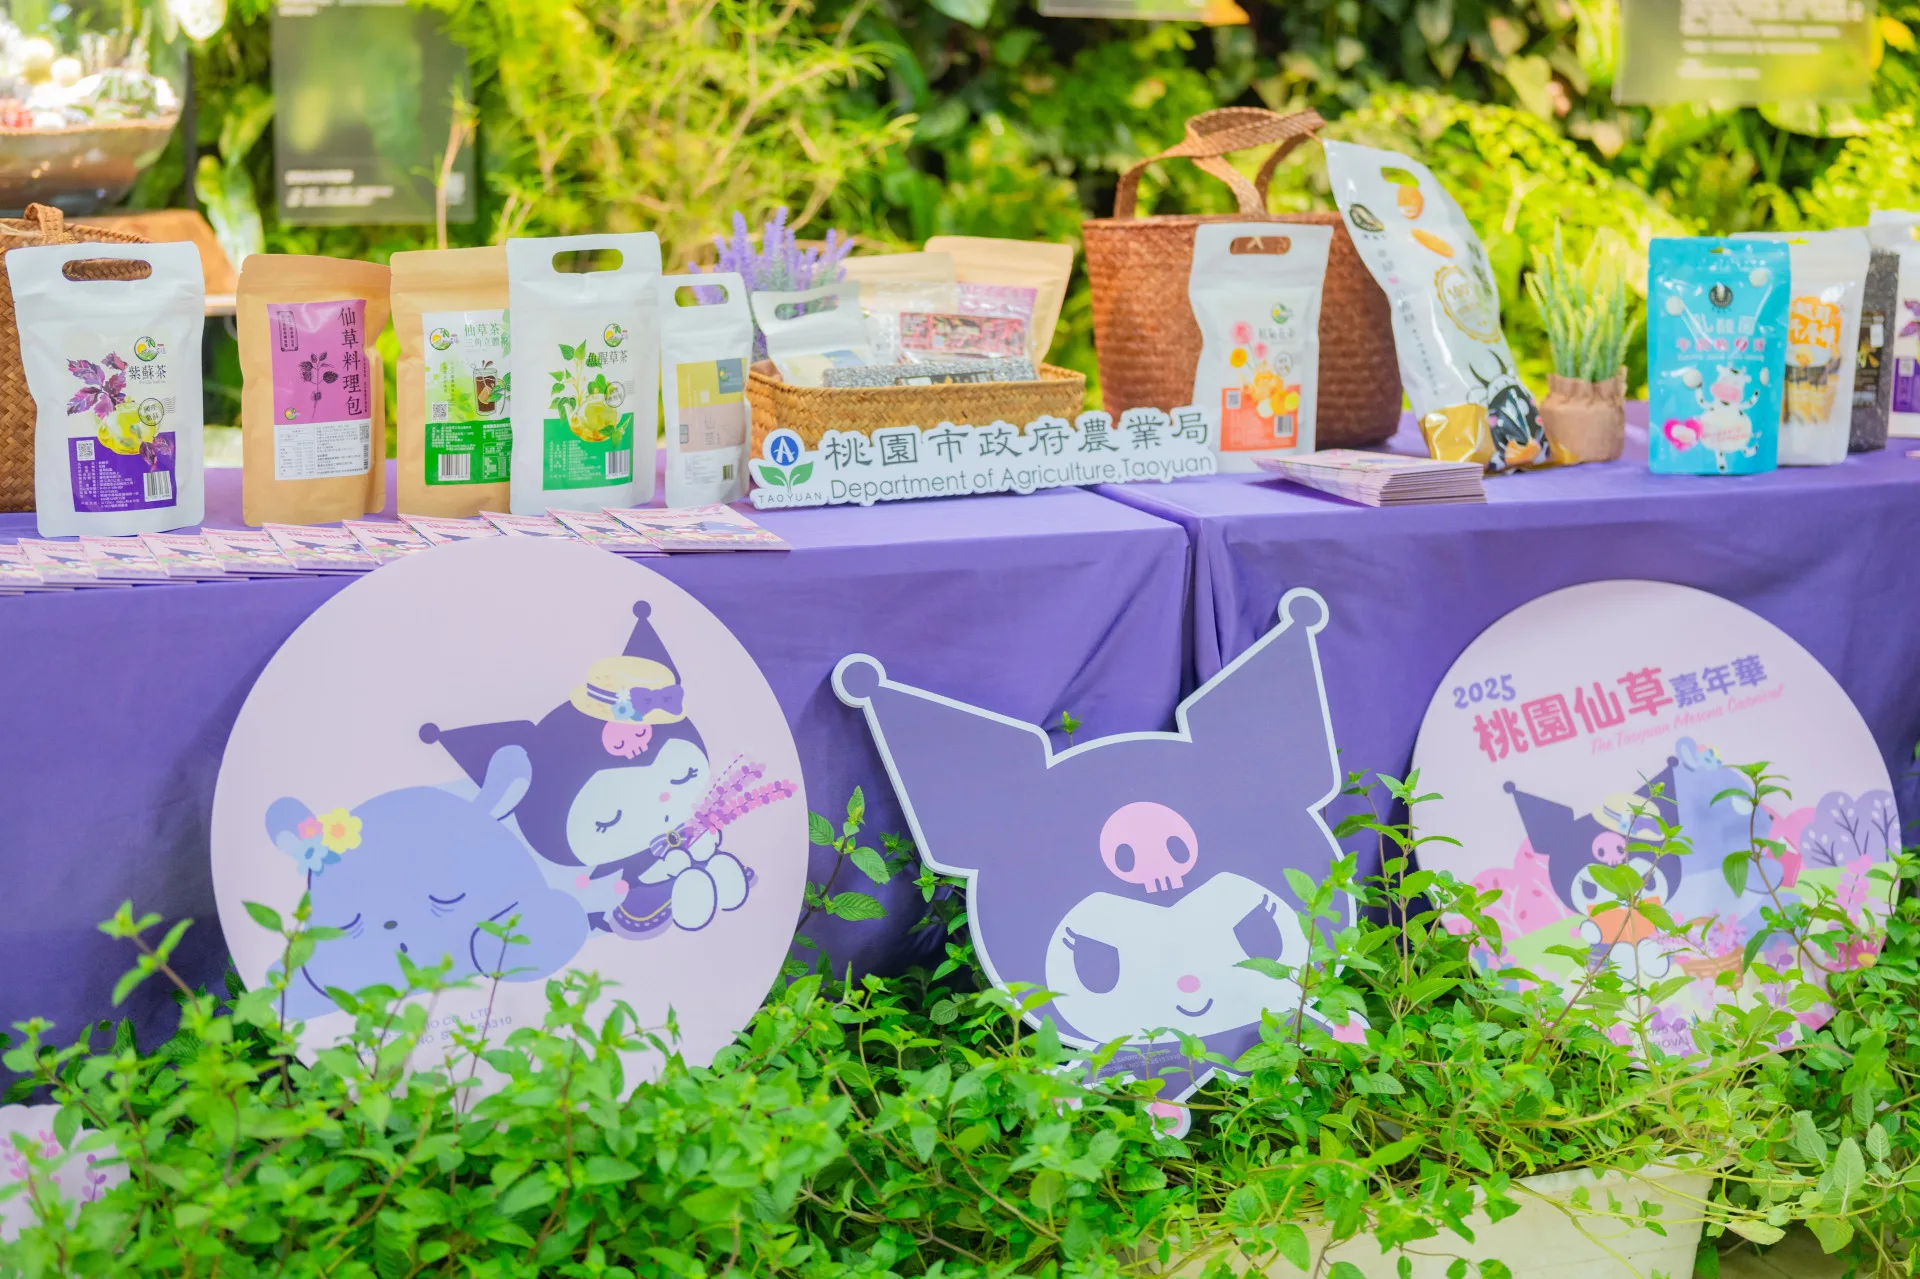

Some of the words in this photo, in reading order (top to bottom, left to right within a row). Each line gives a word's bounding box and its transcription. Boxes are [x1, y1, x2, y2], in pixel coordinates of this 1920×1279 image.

[464, 322, 501, 337] 仙草茶
[128, 364, 167, 380] 紫蘇茶
[338, 307, 363, 416] 仙草料理包
[587, 350, 628, 367] 魚腥草茶
[825, 411, 1208, 471] 桃園市政府農業局
[758, 492, 822, 504] TAOYUAN
[831, 471, 967, 501] Department
[974, 468, 994, 488] of
[1453, 674, 1517, 709] 2025
[1589, 737, 1613, 755] The
[1673, 705, 1724, 729] Mesona
